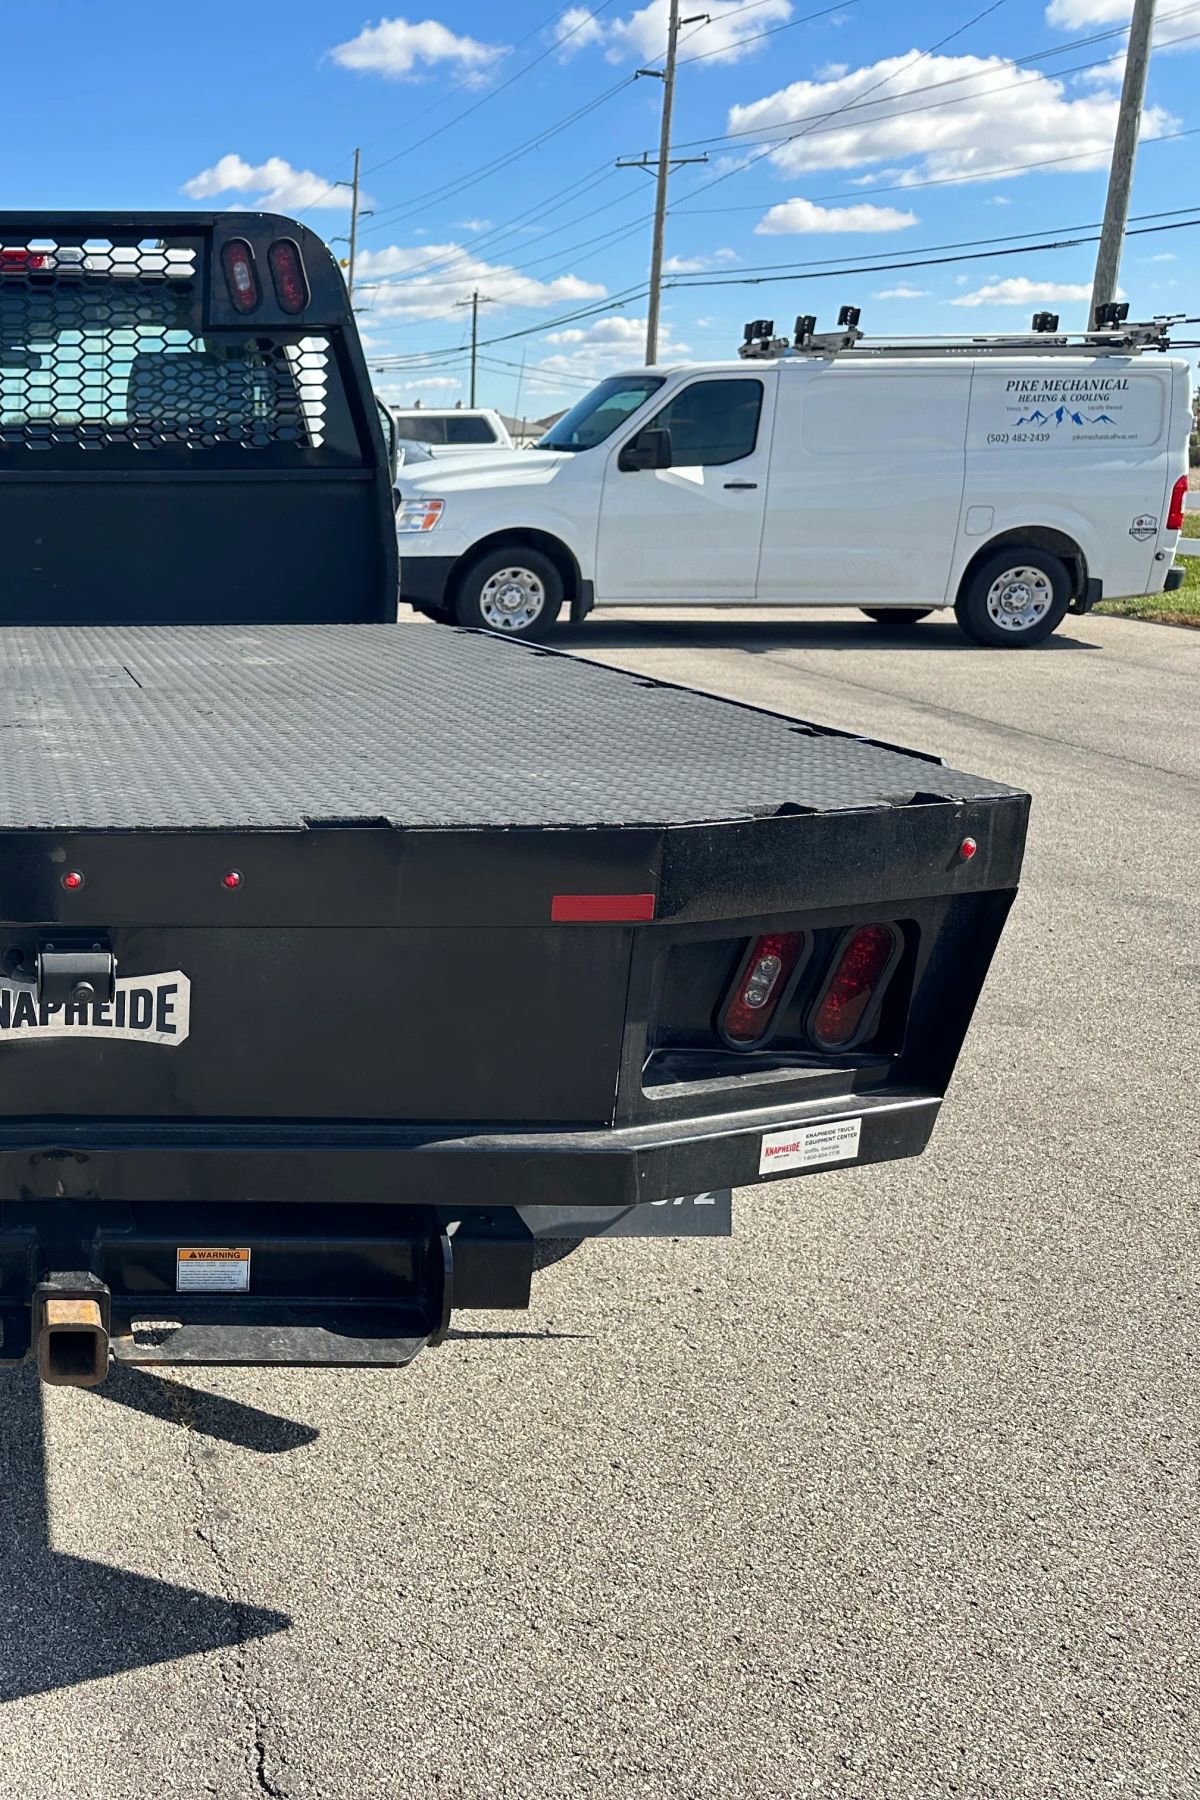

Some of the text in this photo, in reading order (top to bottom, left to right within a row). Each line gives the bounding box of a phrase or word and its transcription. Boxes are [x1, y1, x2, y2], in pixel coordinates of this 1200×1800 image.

[1005, 379, 1129, 392] PIKE MECHANICAL
[1018, 393, 1110, 403] HEATING & COOLING
[986, 433, 1050, 444] (502) 482-2439
[805, 1126, 855, 1139] KNAPHEIDE TRUCK
[805, 1132, 858, 1146] EQUIPMENT CENTER
[765, 1141, 800, 1157] KNAPHEIDE
[197, 1251, 241, 1259] WARNING
